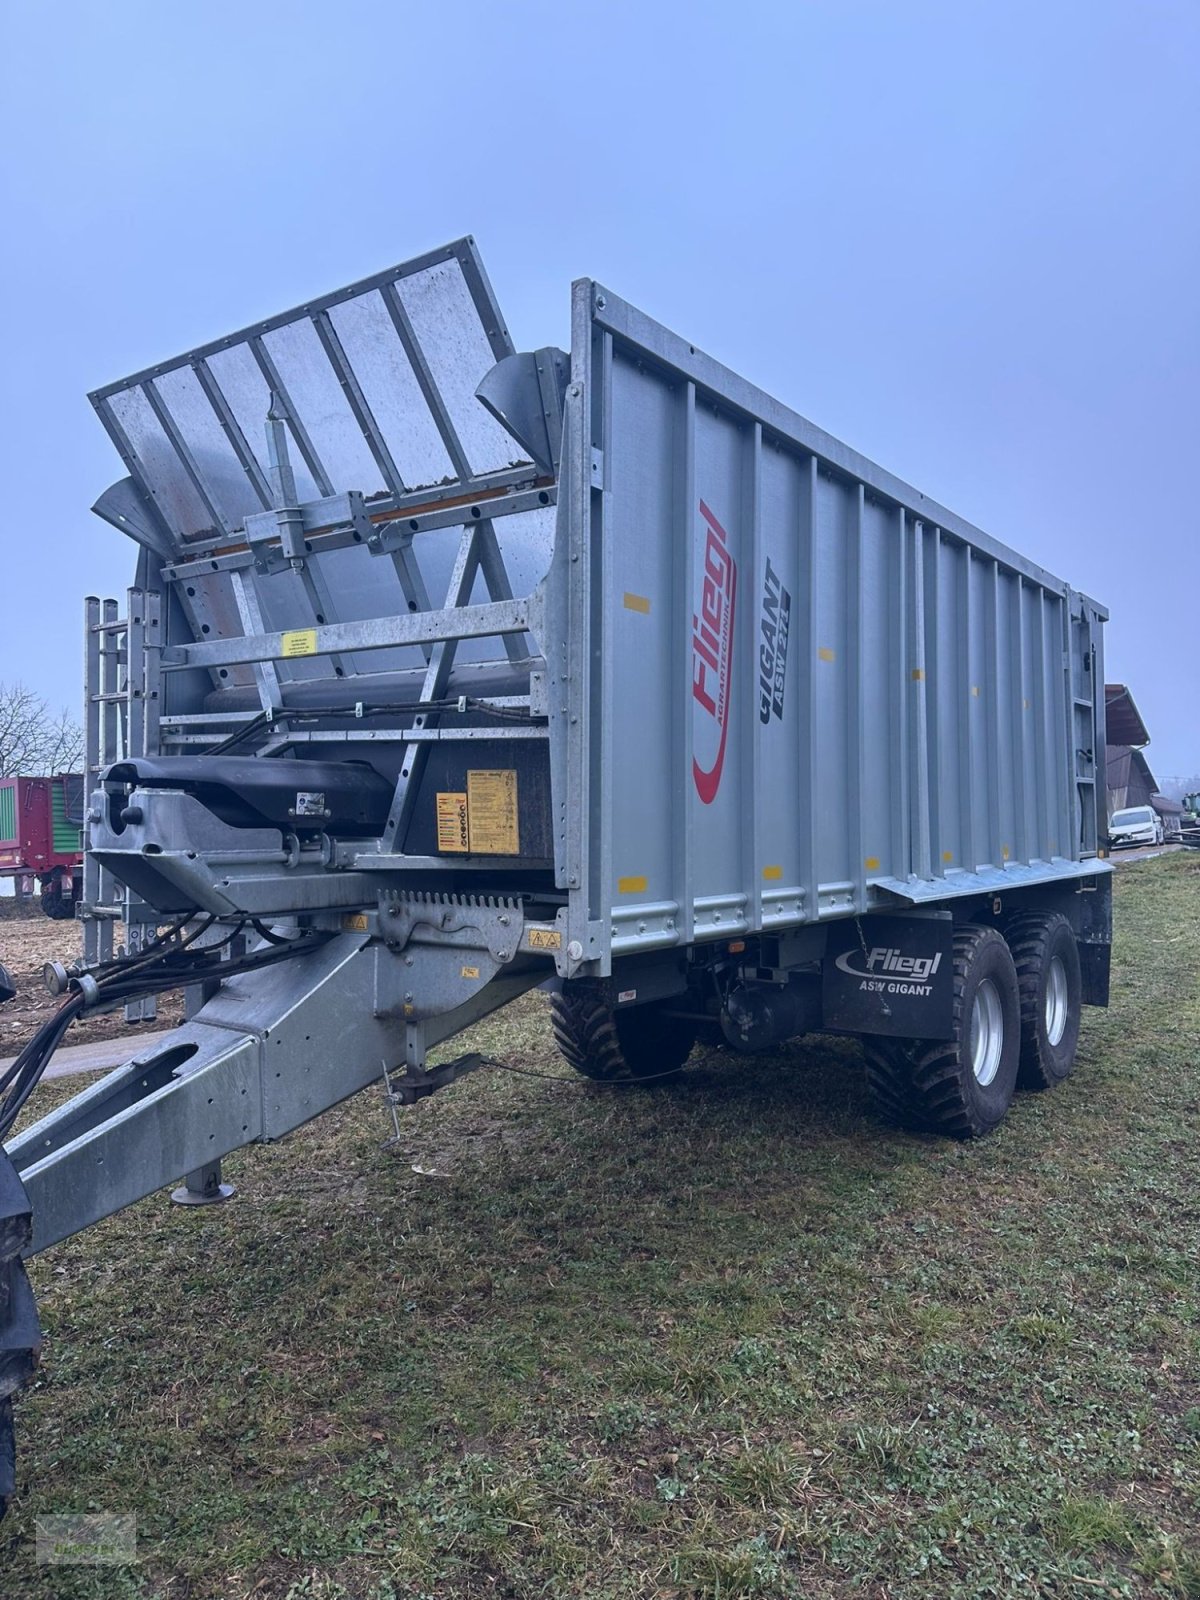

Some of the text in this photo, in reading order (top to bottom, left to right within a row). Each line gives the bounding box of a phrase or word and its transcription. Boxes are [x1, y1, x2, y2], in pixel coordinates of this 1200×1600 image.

[692, 498, 732, 717] Fliegl
[759, 556, 781, 725] GIGANT
[772, 608, 790, 706] ASW 271
[716, 601, 731, 727] AGRARTECHNIK
[859, 980, 933, 996] ASW GIGANT
[866, 947, 942, 977] Fliegl
